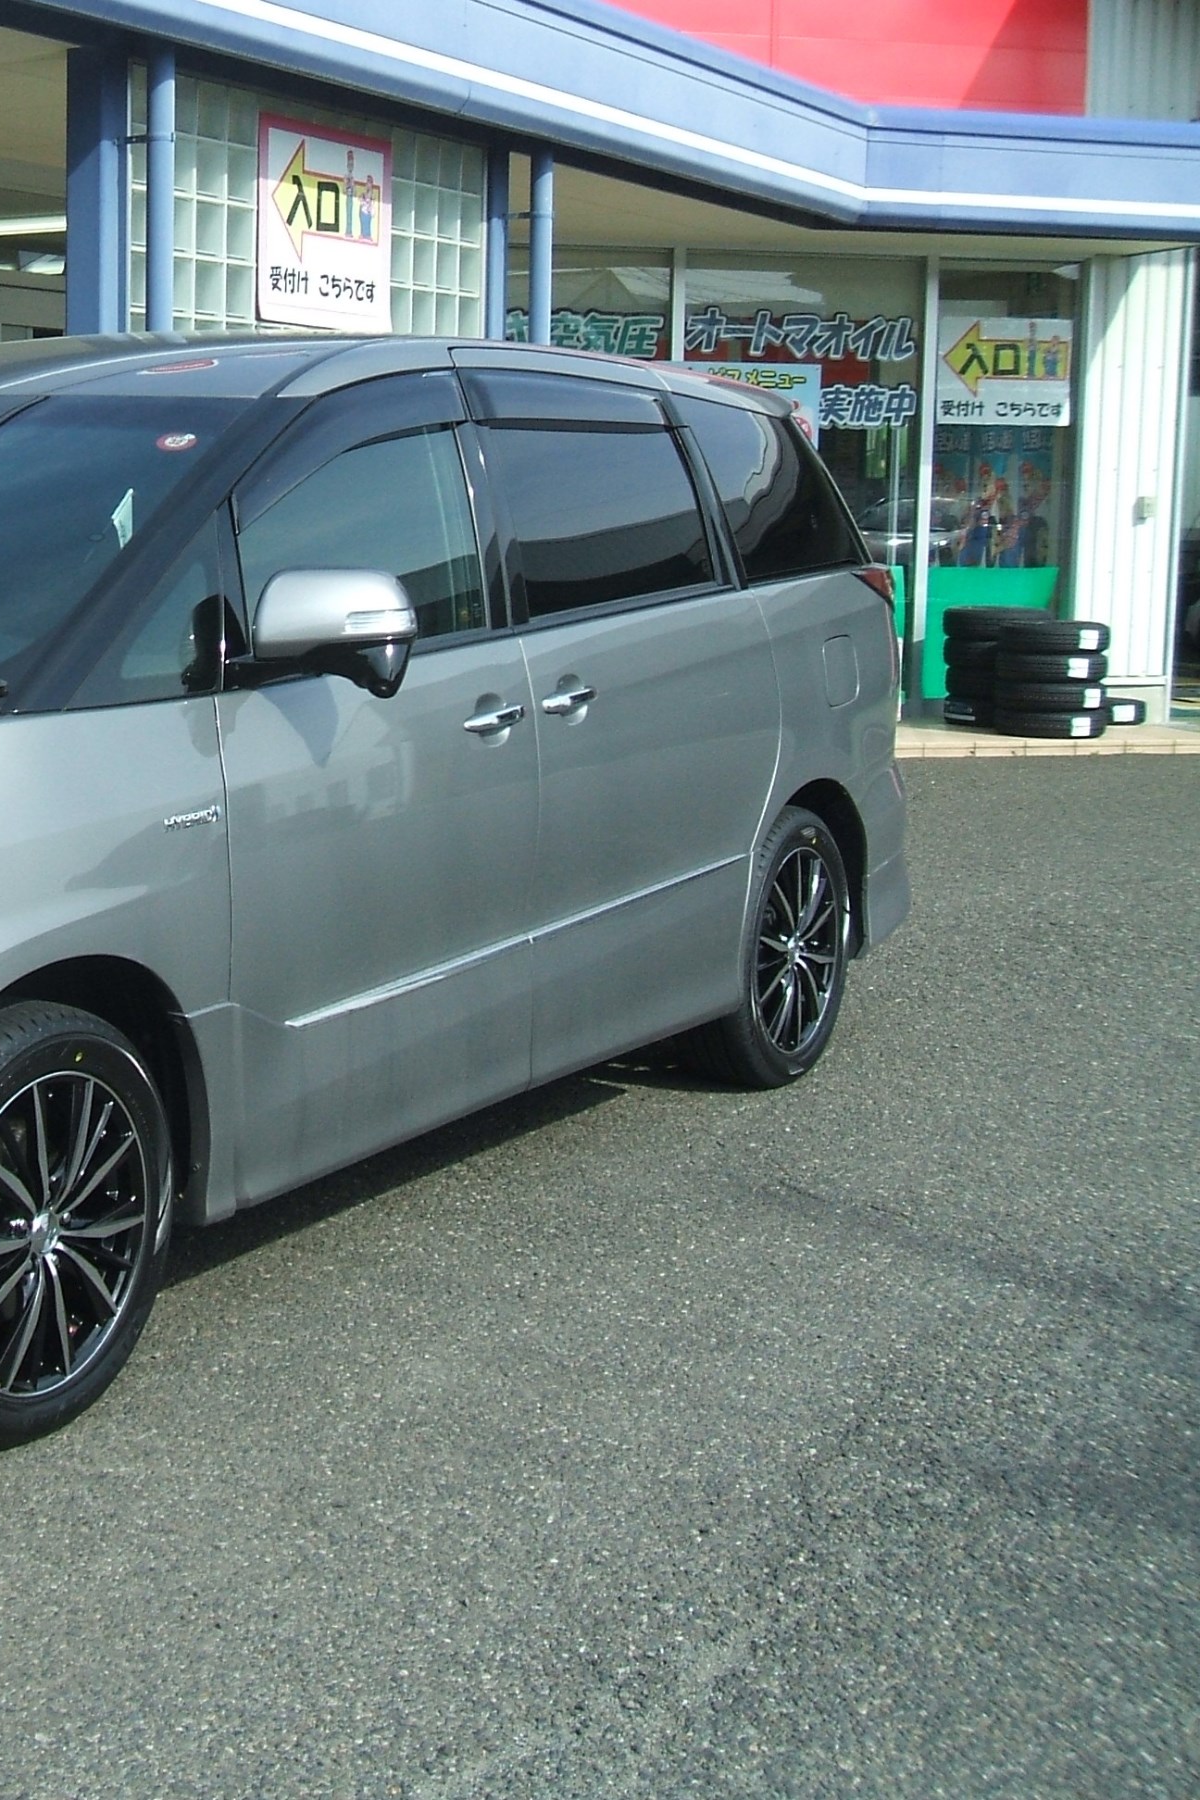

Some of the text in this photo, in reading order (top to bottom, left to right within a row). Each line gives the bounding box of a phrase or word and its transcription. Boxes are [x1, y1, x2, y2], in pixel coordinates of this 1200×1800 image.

[286, 174, 340, 233] 入口
[269, 265, 376, 304] 受付け こちらです
[684, 307, 916, 362] オートマオイル
[958, 343, 1021, 376] 入口
[818, 384, 917, 430] 実施中
[940, 400, 1064, 418] 受付け こちらです
